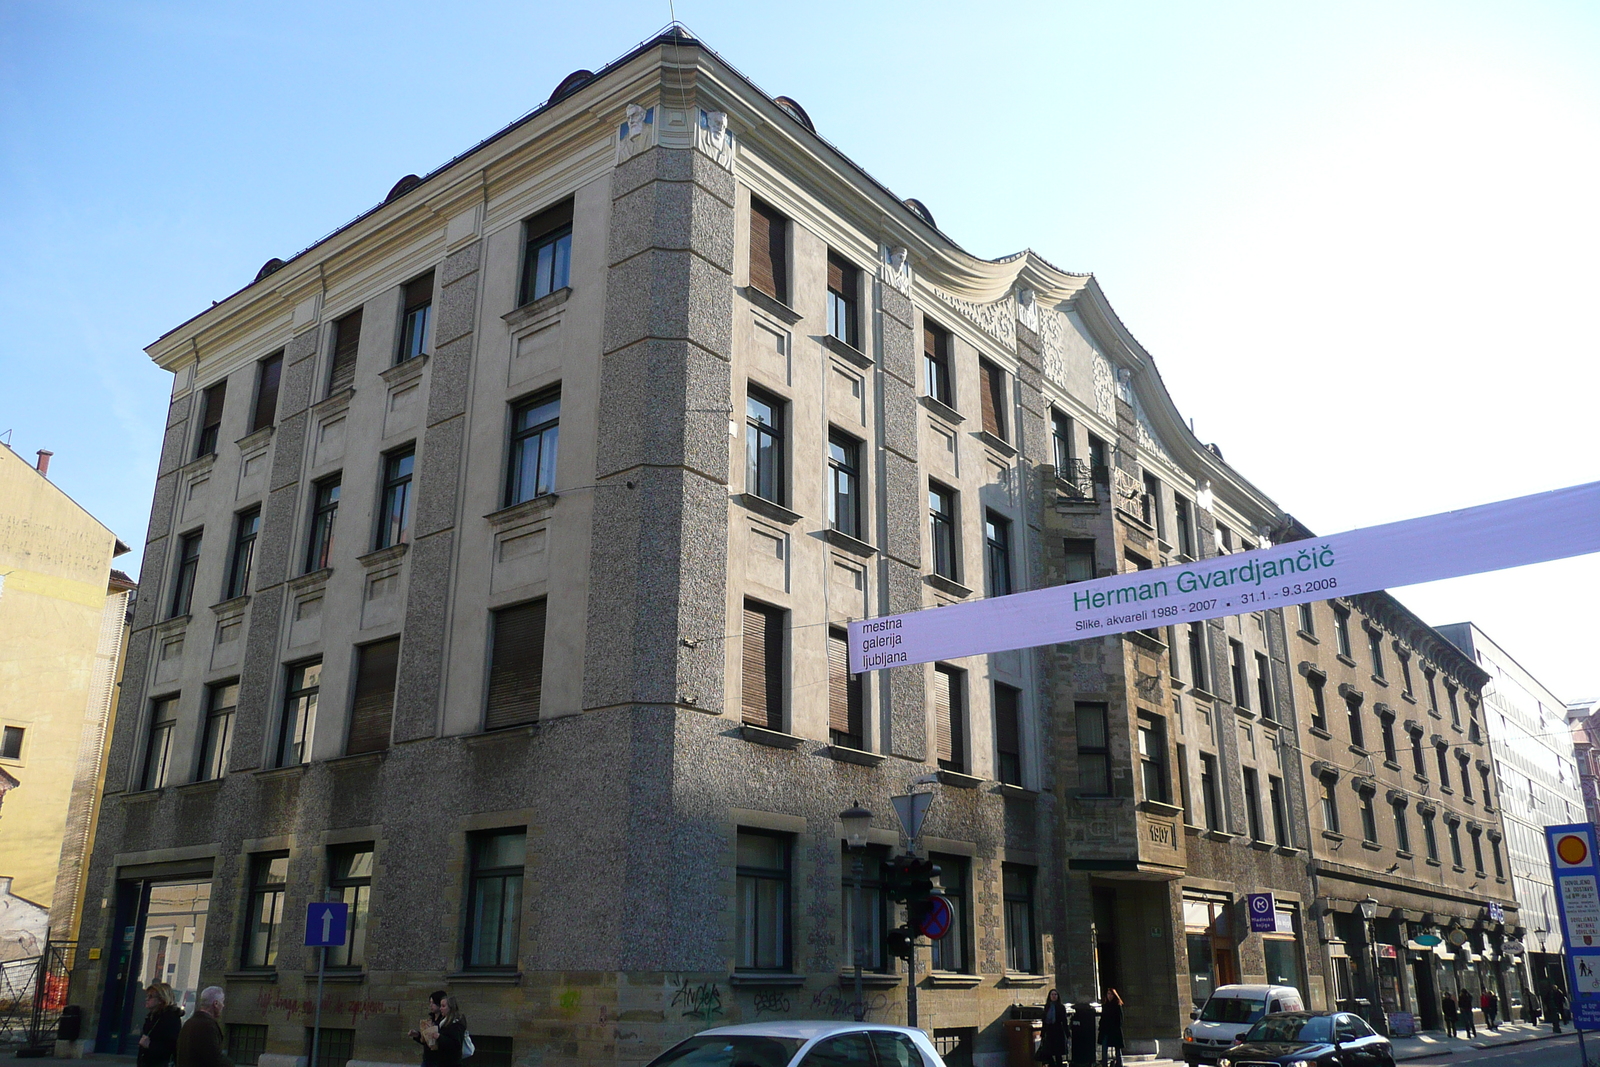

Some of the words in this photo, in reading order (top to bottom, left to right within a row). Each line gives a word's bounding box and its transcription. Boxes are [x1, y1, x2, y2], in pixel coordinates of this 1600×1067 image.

[1073, 581, 1168, 611] Herman
[1176, 544, 1335, 593] Gvardjančič
[1075, 619, 1104, 631] Slike,
[1106, 611, 1148, 626] akvareli
[1152, 605, 1178, 619] 1988
[1188, 599, 1218, 613] 2007
[1241, 590, 1271, 604] 31.1.
[1282, 577, 1338, 597] 9.3.2008
[862, 619, 903, 634] mestna
[862, 633, 902, 653] galerija
[862, 652, 908, 670] ljubljana
[1150, 825, 1169, 843] 1907
